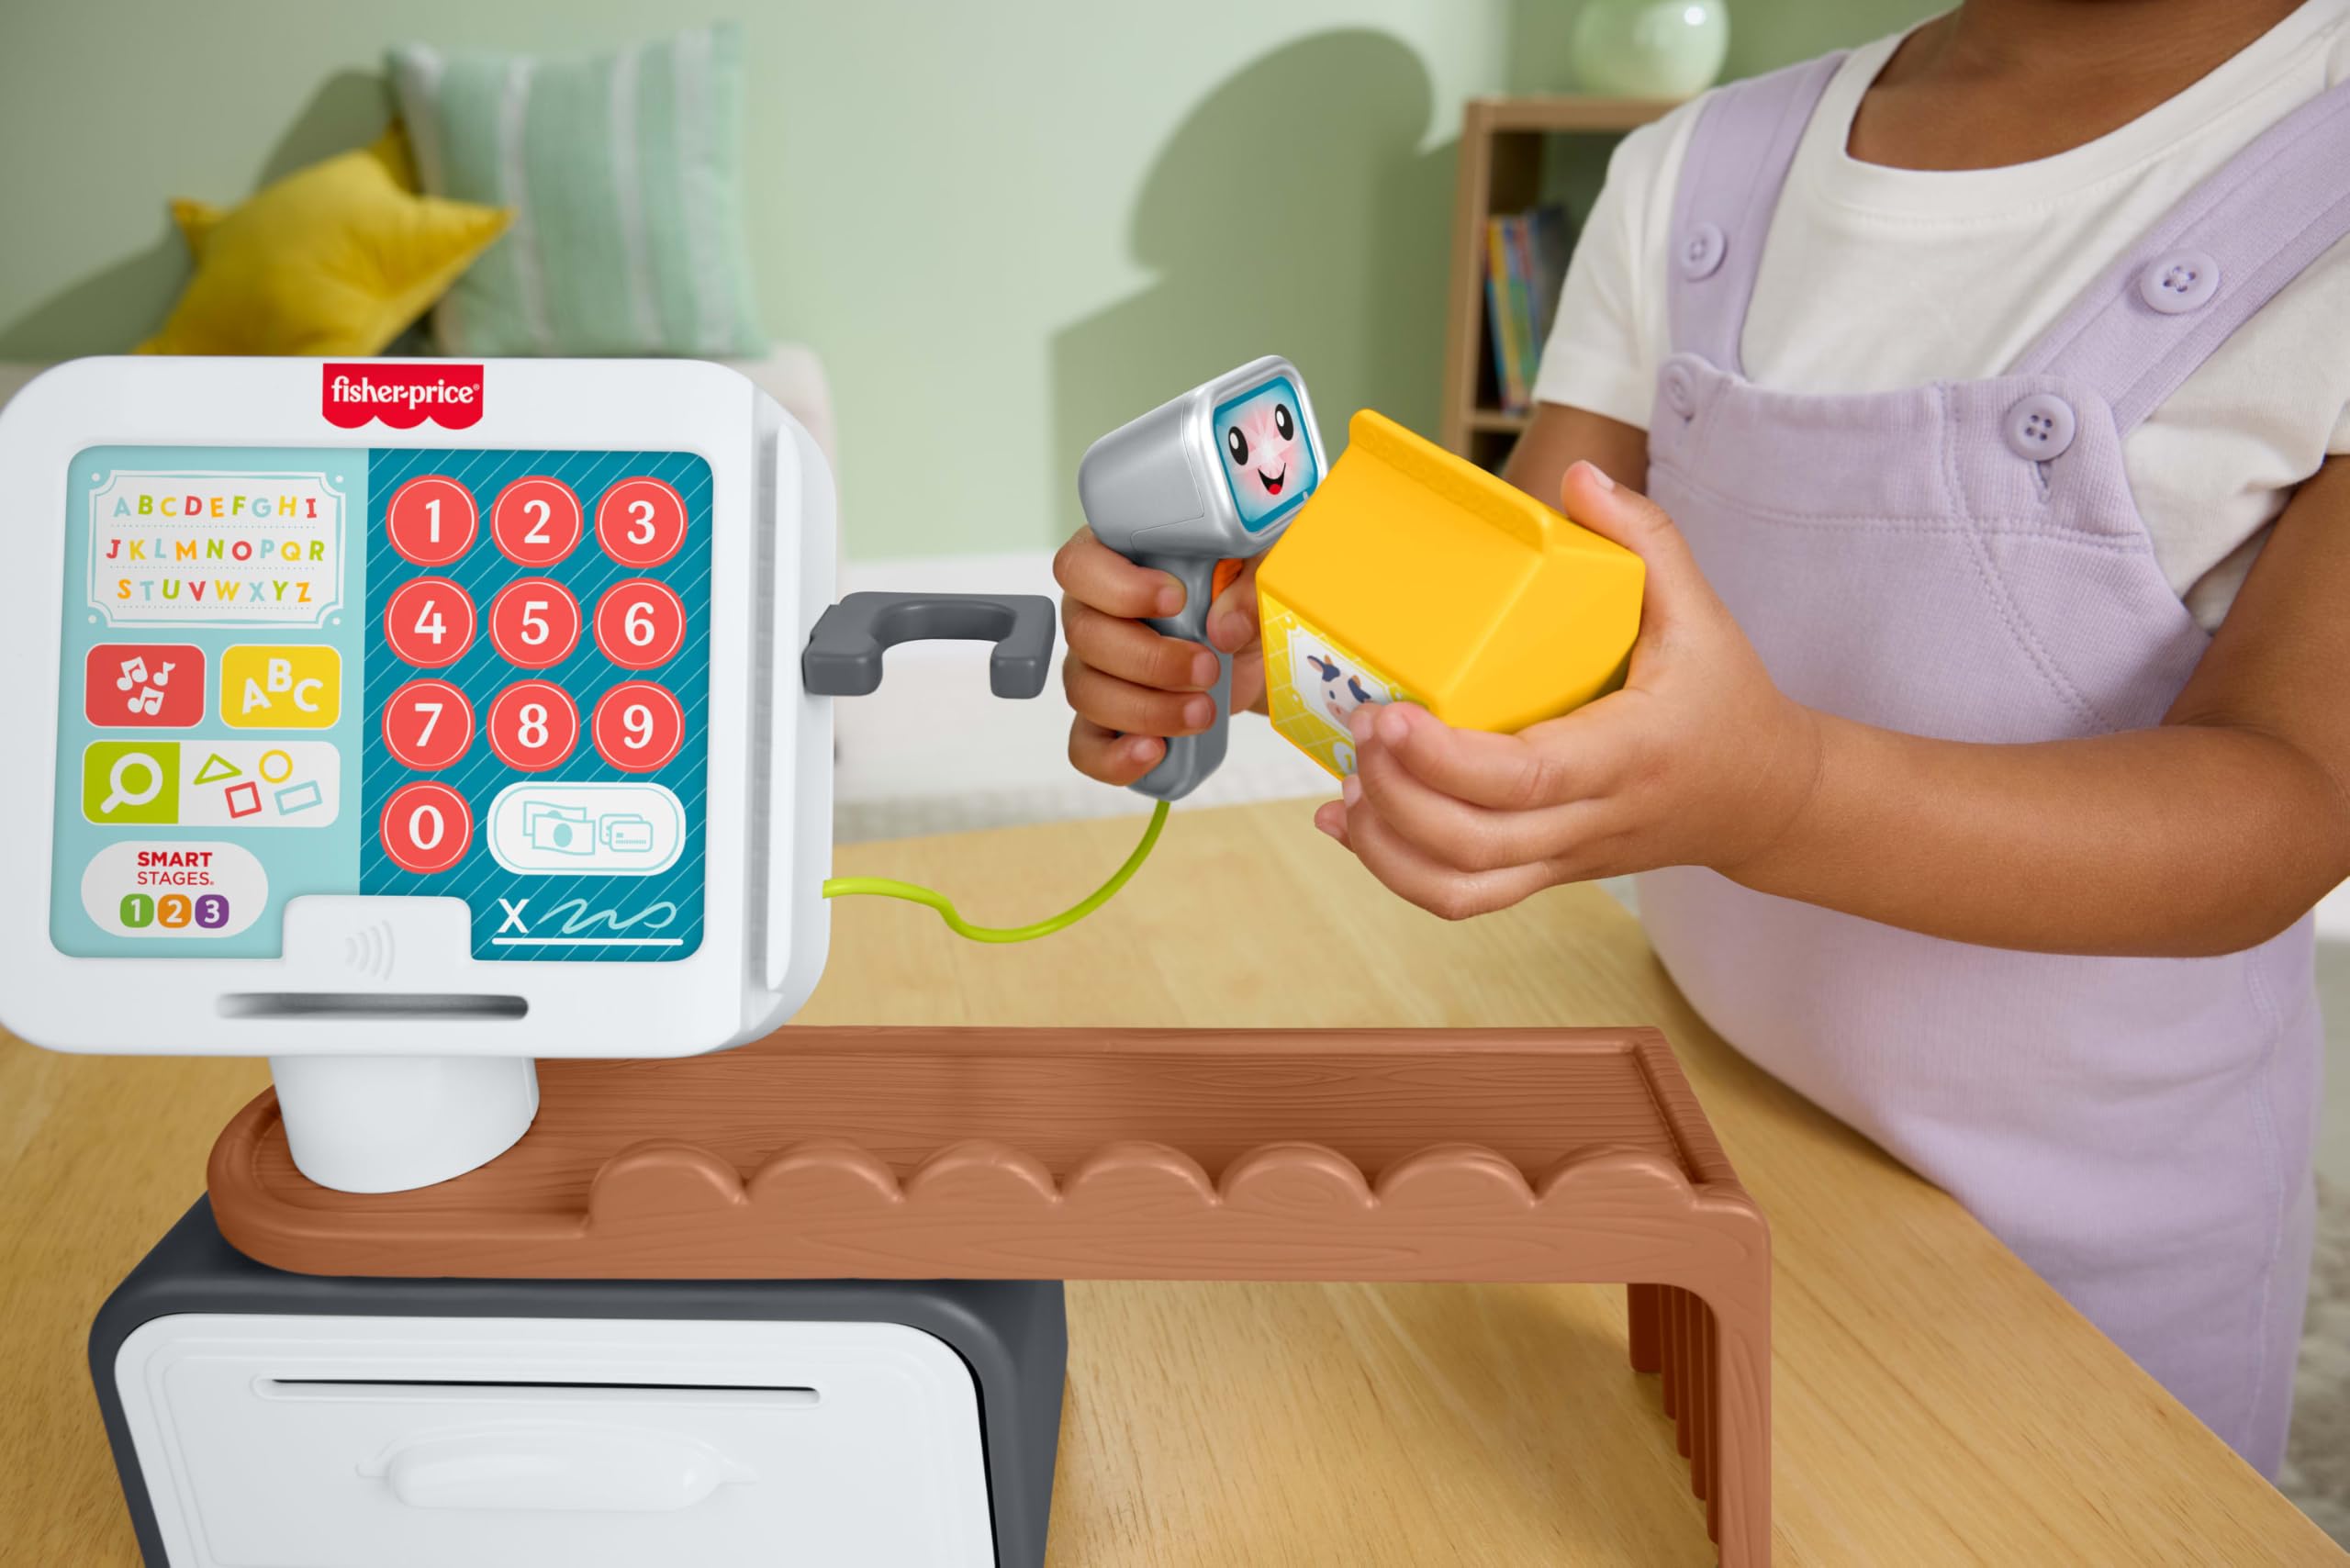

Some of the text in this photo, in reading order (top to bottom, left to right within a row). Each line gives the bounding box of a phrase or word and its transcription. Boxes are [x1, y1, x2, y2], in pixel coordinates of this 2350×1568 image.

[425, 498, 655, 545] 1 2 3
[414, 600, 655, 646] 4 5 6
[414, 703, 654, 749] 7 8 9
[408, 804, 445, 851] 0
[137, 850, 213, 868] SMART
[130, 898, 220, 924] 1 2 3
